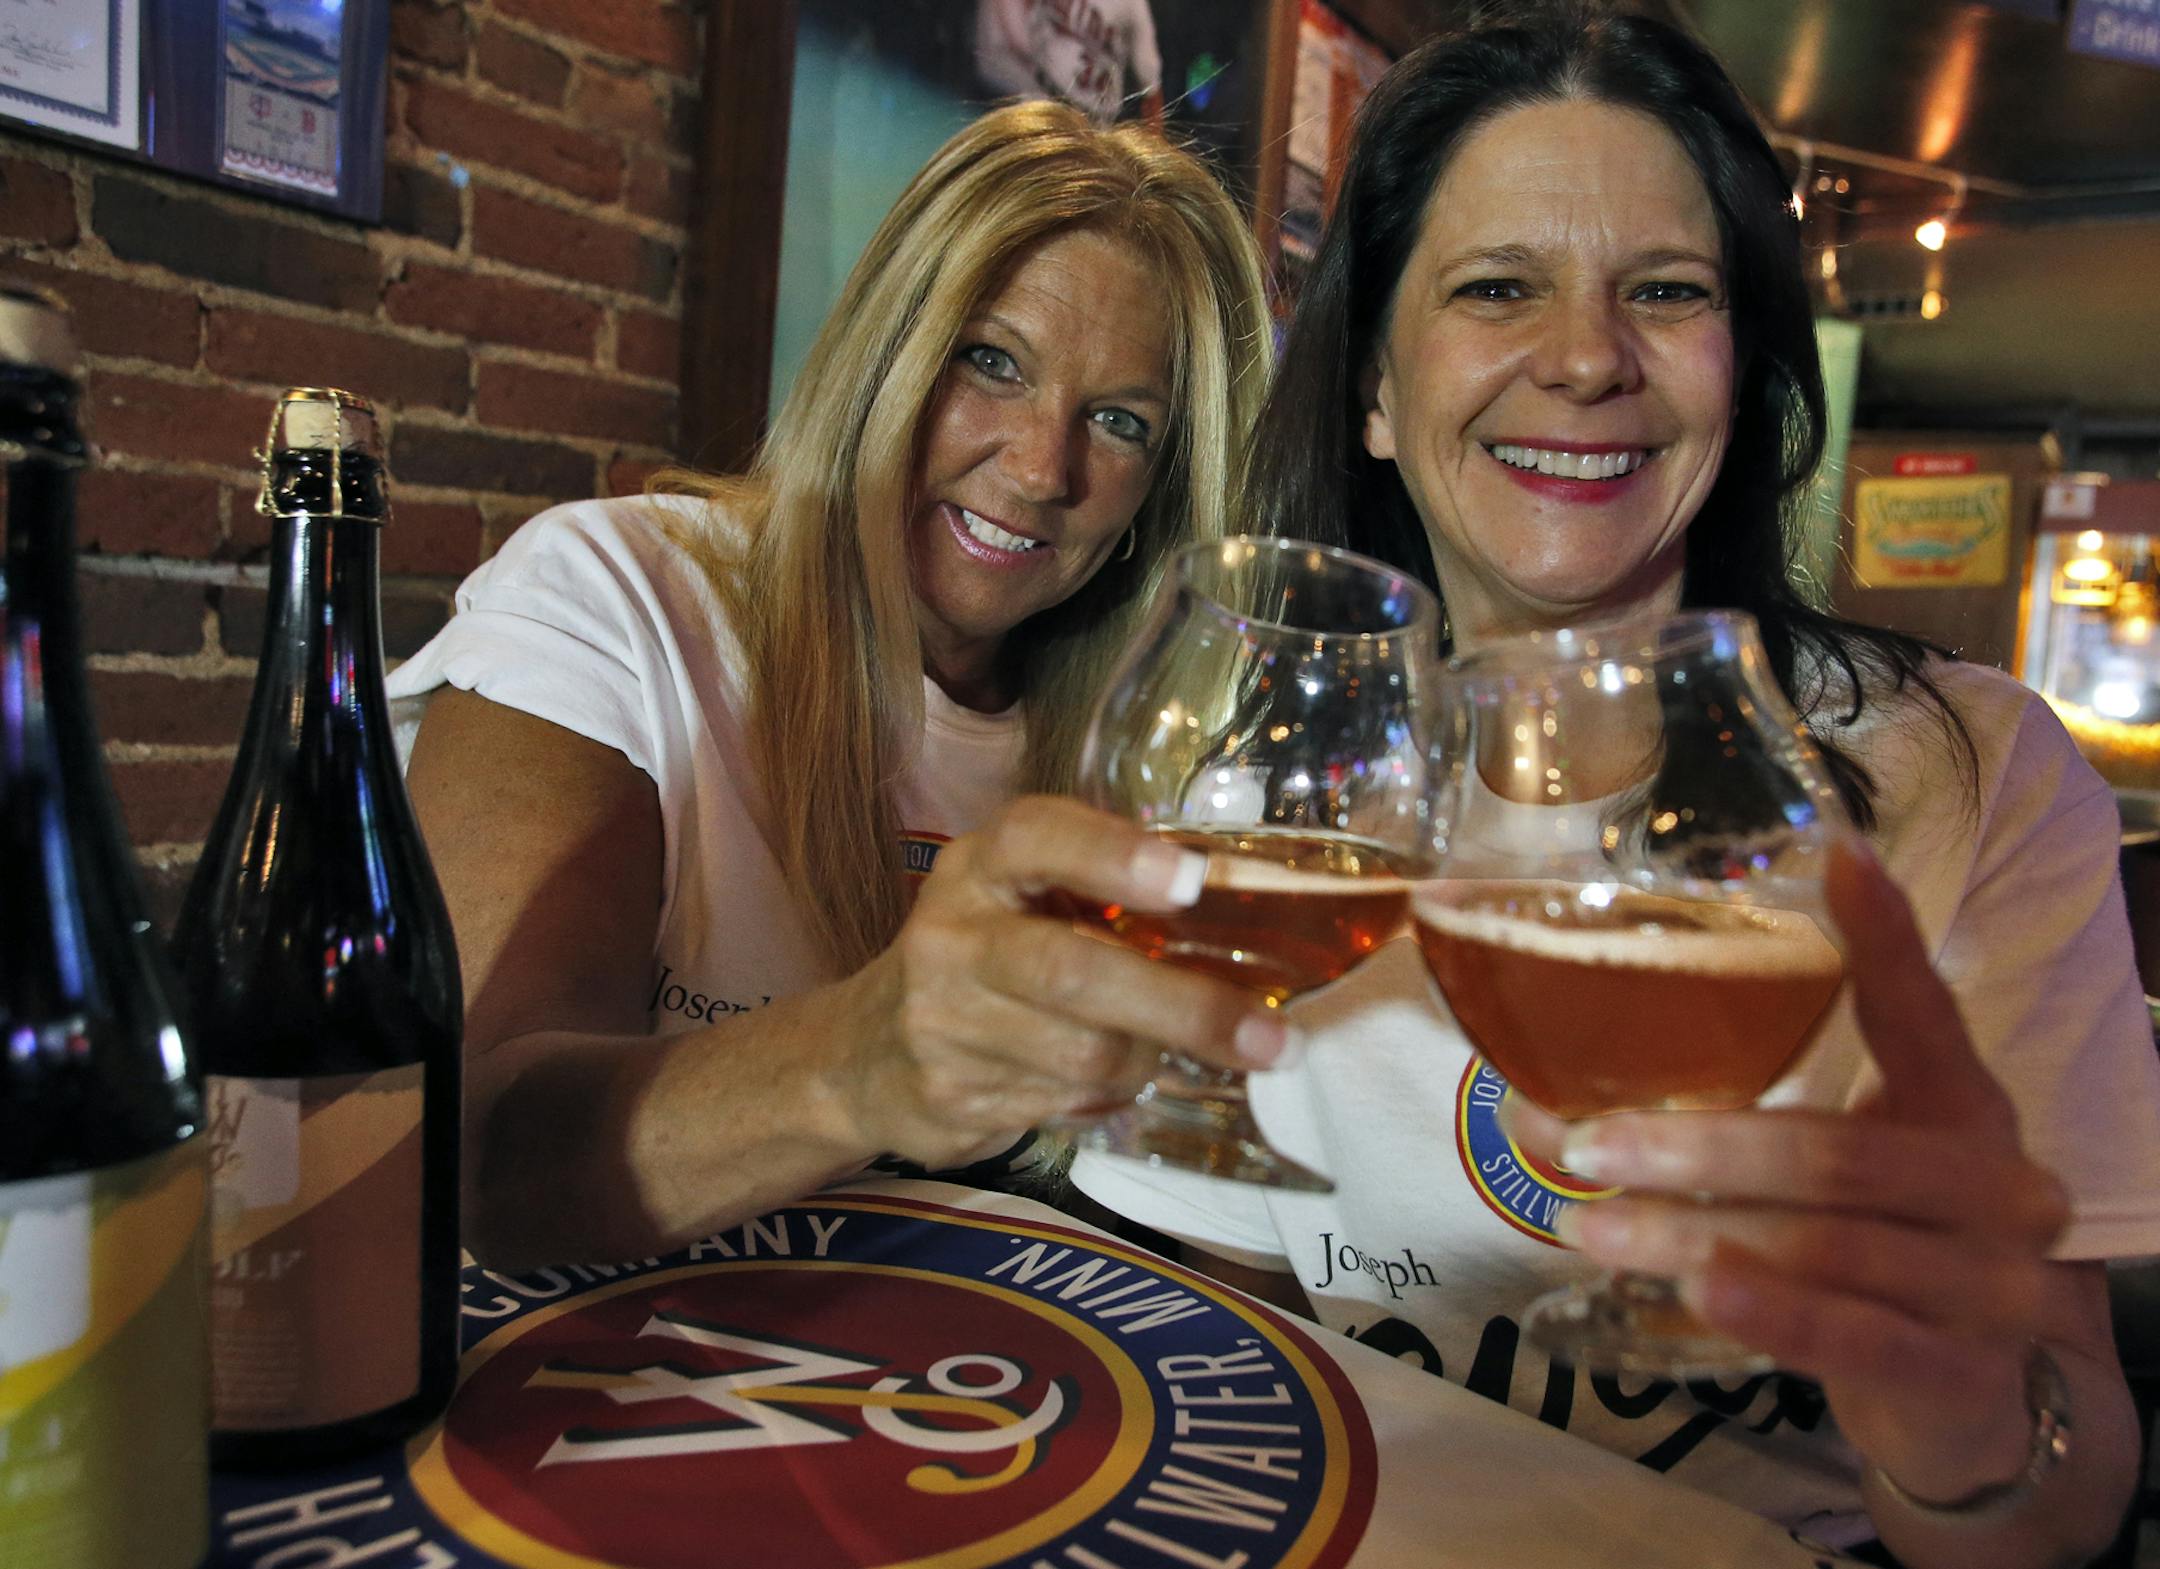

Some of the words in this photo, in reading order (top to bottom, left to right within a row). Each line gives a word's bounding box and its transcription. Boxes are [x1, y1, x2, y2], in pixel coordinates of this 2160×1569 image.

[1482, 1153, 1566, 1226] STILLW
[985, 1238, 1211, 1334] MINN.
[1315, 1232, 1441, 1300] Joseph
